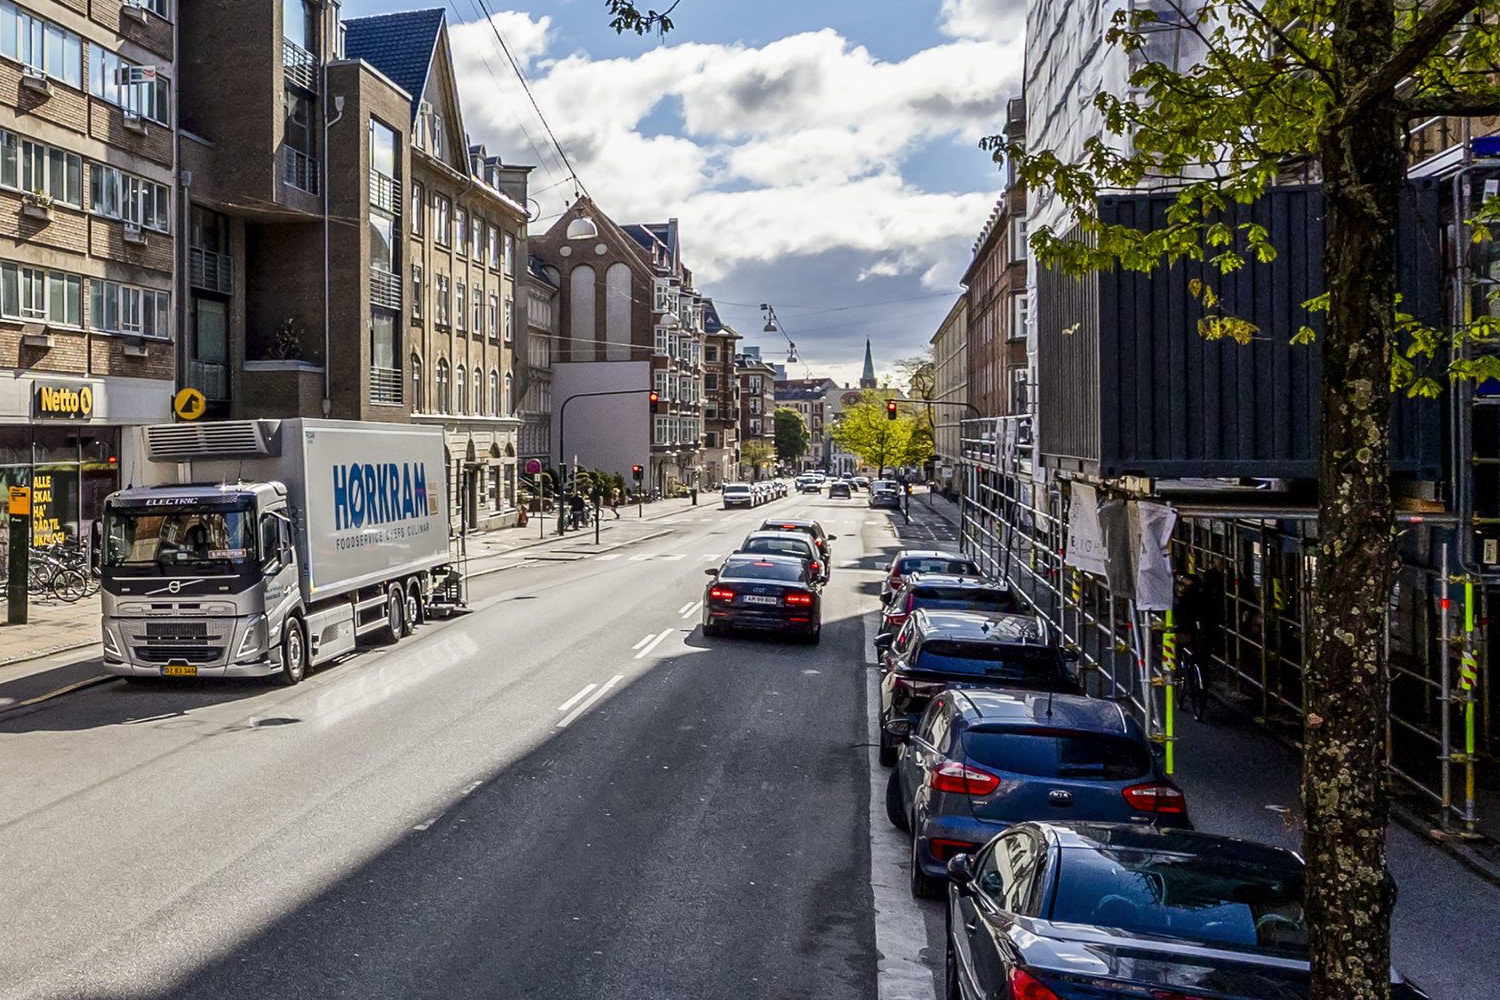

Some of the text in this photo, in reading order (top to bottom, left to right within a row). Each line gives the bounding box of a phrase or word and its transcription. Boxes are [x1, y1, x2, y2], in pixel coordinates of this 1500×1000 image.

[41, 386, 80, 413] Netto
[33, 475, 51, 489] ALLE
[33, 490, 52, 503] SKAL
[145, 497, 199, 506] ELECTRIC
[333, 462, 429, 531] HØRKRAM
[49, 518, 61, 531] TIL
[336, 530, 383, 551] FOODSERVICE
